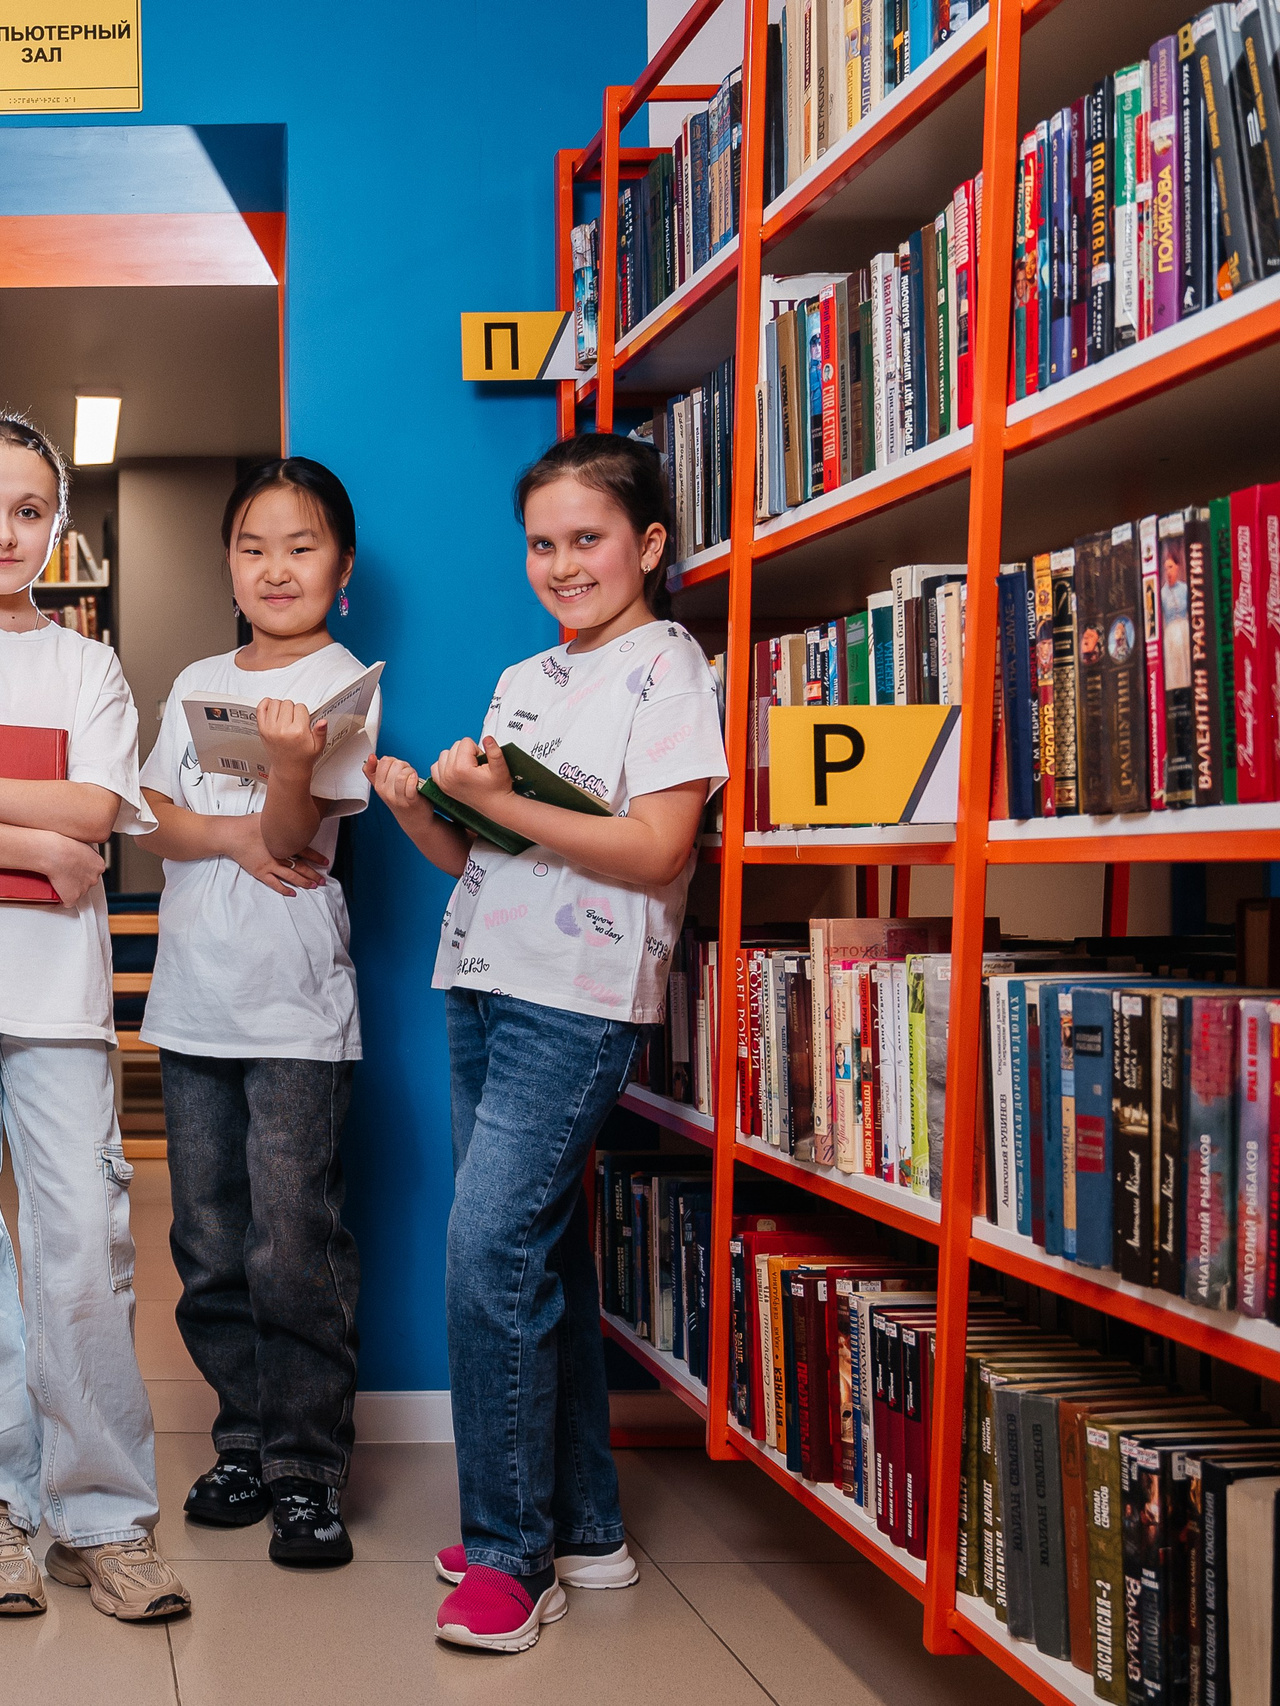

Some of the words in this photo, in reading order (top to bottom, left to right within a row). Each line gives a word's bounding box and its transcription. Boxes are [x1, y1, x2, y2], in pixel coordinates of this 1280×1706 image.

[21, 47, 62, 62] ЗАЛ
[1158, 165, 1174, 273] ПОЛЯКОВА
[901, 275, 910, 329] БАТАЛЬОНЫ
[484, 322, 519, 370] П
[903, 331, 912, 381] ШТРАФНЫЕ
[904, 383, 914, 406] ИДУТ
[905, 409, 914, 447] ПРОРЫВ
[895, 577, 904, 638] баталиста
[1026, 589, 1037, 640] ИНДИГО
[1190, 542, 1207, 661] РАСПУТИН
[895, 642, 905, 696] Рисунки
[928, 637, 938, 677] АЛЕКСАНДР
[1194, 668, 1212, 790] ВАЛЕНТИН
[814, 724, 865, 806] Р
[735, 956, 746, 1003] ОЛЕГ
[750, 970, 760, 1020] ОЛЕГ
[736, 1008, 749, 1047] РОЙ
[864, 1084, 873, 1129] ГОТОВЬСЯ
[1012, 1057, 1023, 1110] ДОРОГА
[864, 1138, 874, 1168] ВОЙНЕ
[1198, 1132, 1211, 1208] РЫБАКОВ
[1244, 1140, 1258, 1217] РЫБАКОВ
[1197, 1209, 1211, 1298] АНАТОЛИЙ
[1243, 1219, 1258, 1307] АНАТОЛИЙ
[774, 1366, 784, 1428] ВИРИНЕЯ
[983, 1480, 993, 1526] ВАРИАНТ
[1204, 1492, 1216, 1566] ПОКОЛЕНИЯ
[1205, 1569, 1216, 1610] МОЕГО
[1095, 1579, 1114, 1682] ЭКСПАНСИЯ-2
[1205, 1615, 1216, 1676] ЧЕЛОВЕКА
